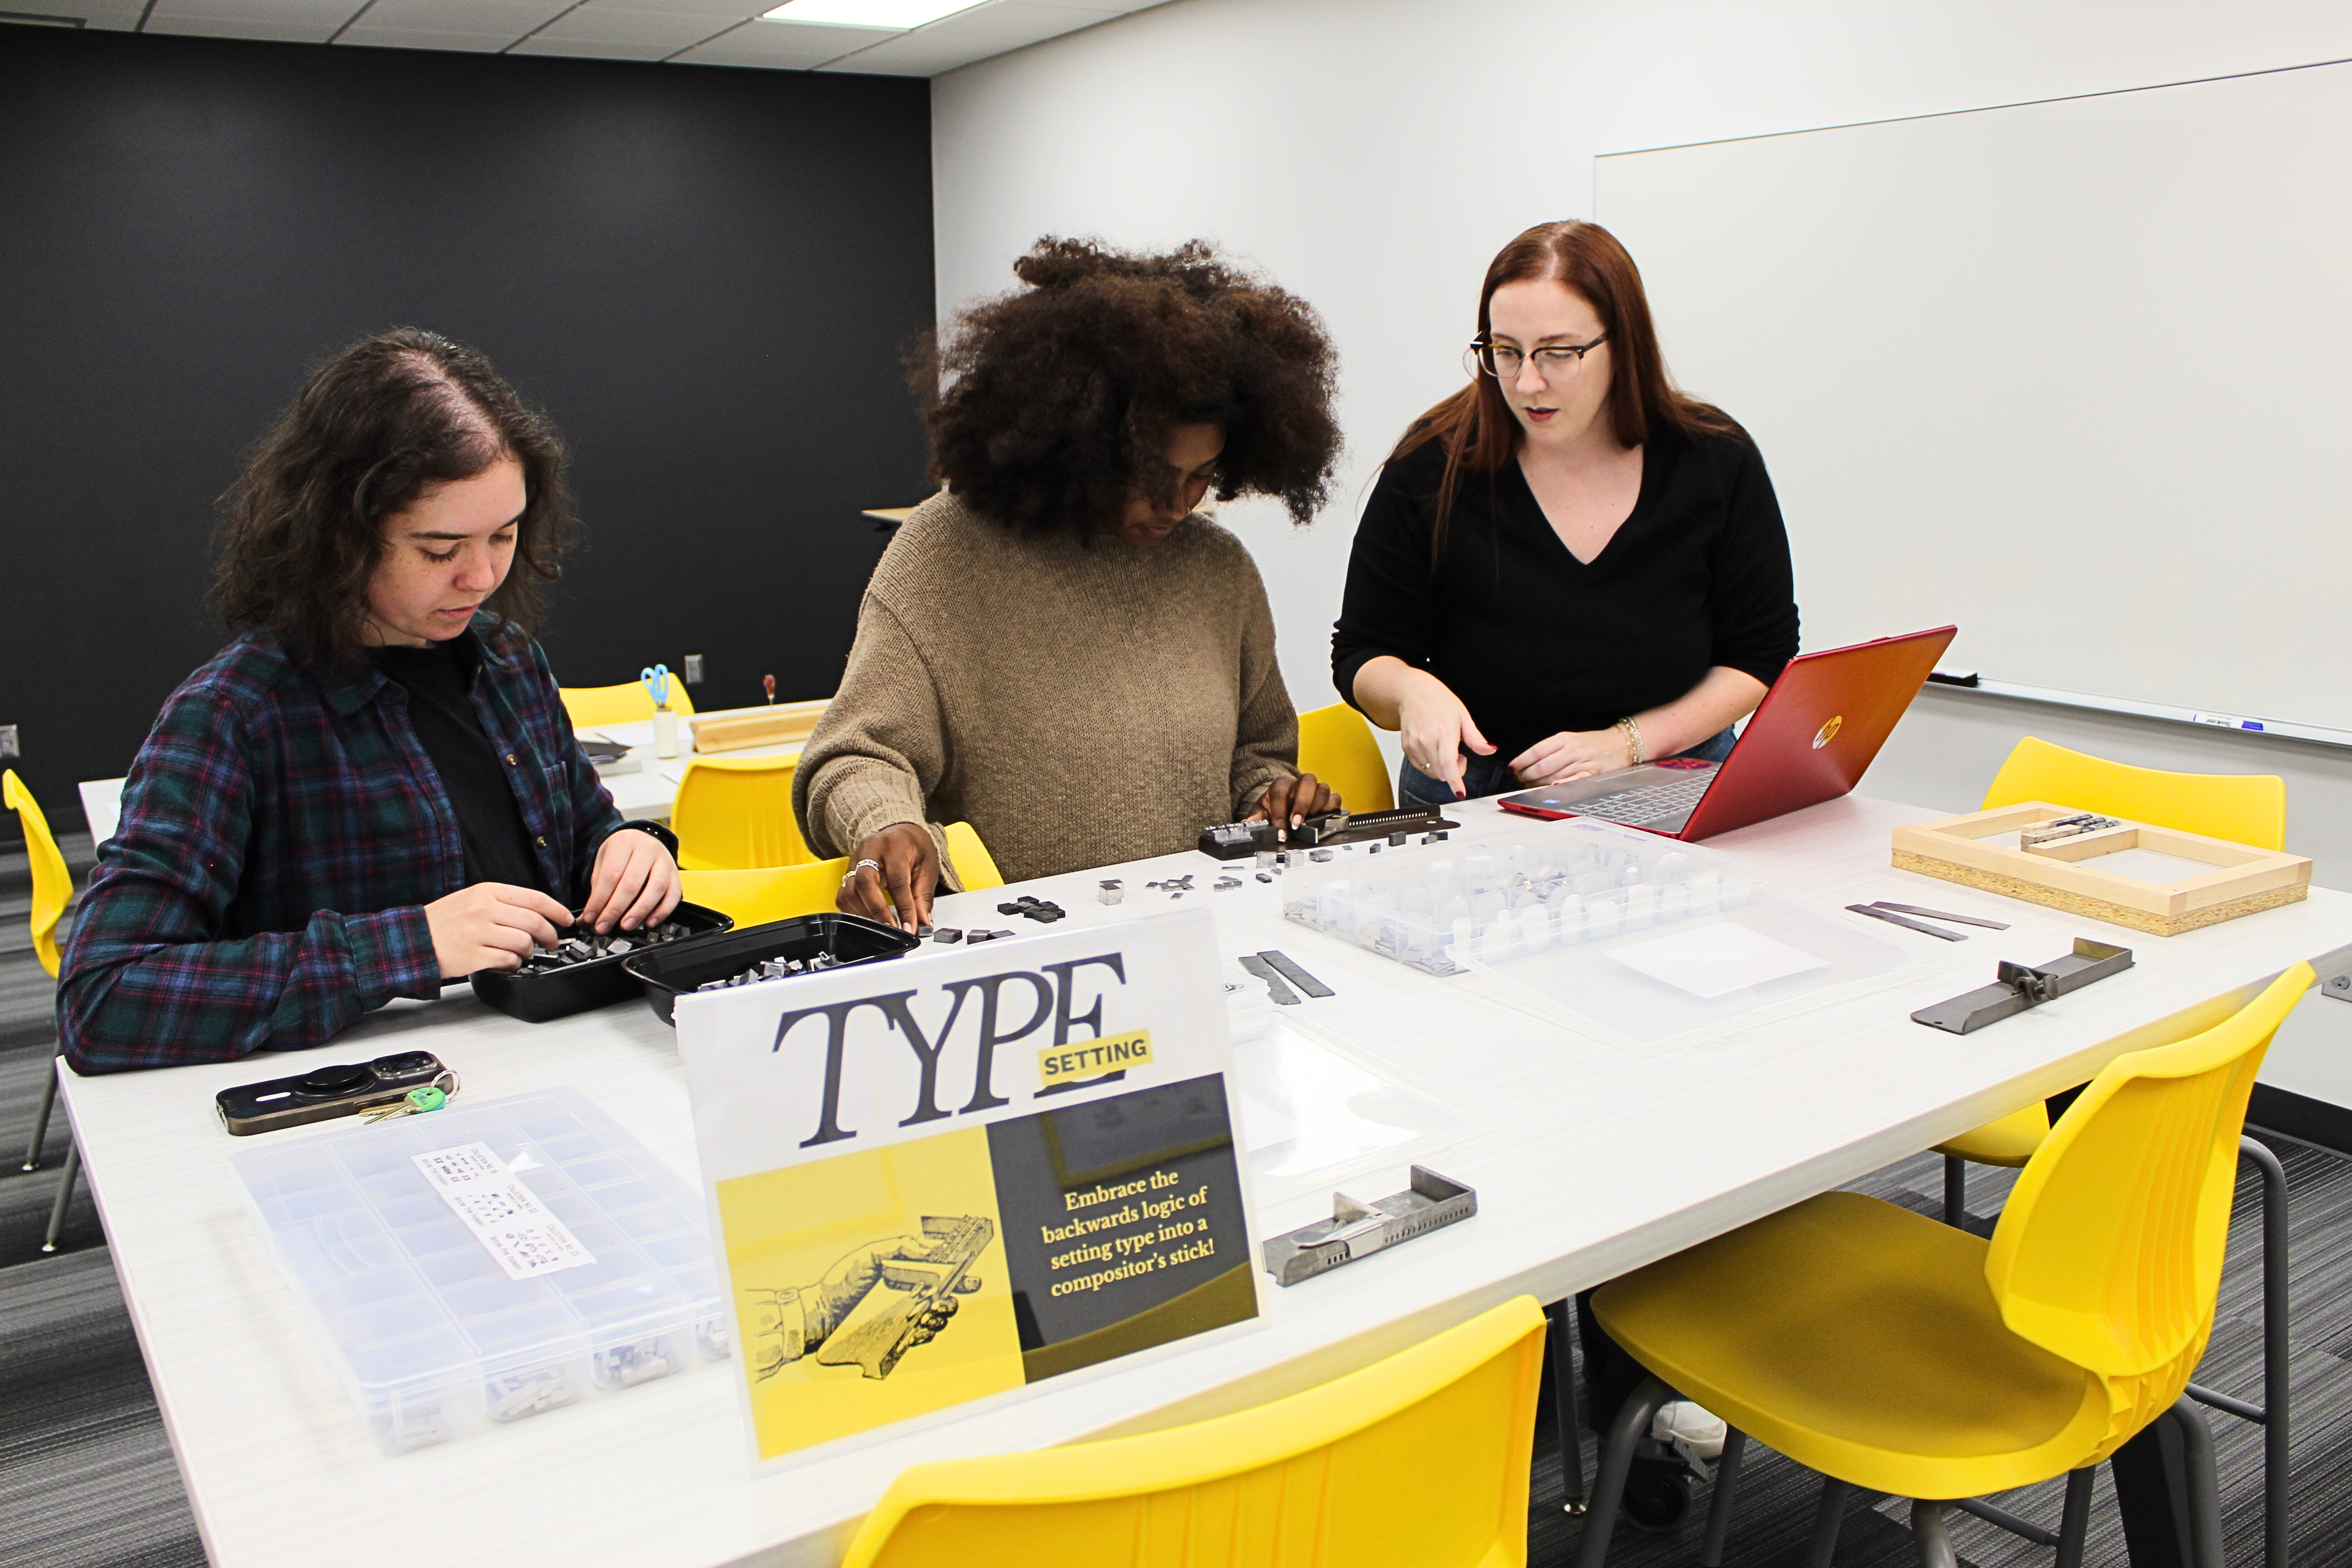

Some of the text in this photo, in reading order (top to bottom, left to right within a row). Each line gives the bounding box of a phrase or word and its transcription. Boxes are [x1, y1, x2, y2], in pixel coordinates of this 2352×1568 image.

[1814, 717, 1841, 749] hp
[772, 952, 1126, 1149] TYPE
[1045, 1039, 1146, 1075] SETTING
[1041, 1186, 1208, 1244] backwards logic of
[1064, 1171, 1179, 1211] Embrace the
[1051, 1218, 1208, 1270] setting type into a
[1051, 1238, 1215, 1297] compositor’s stick!
